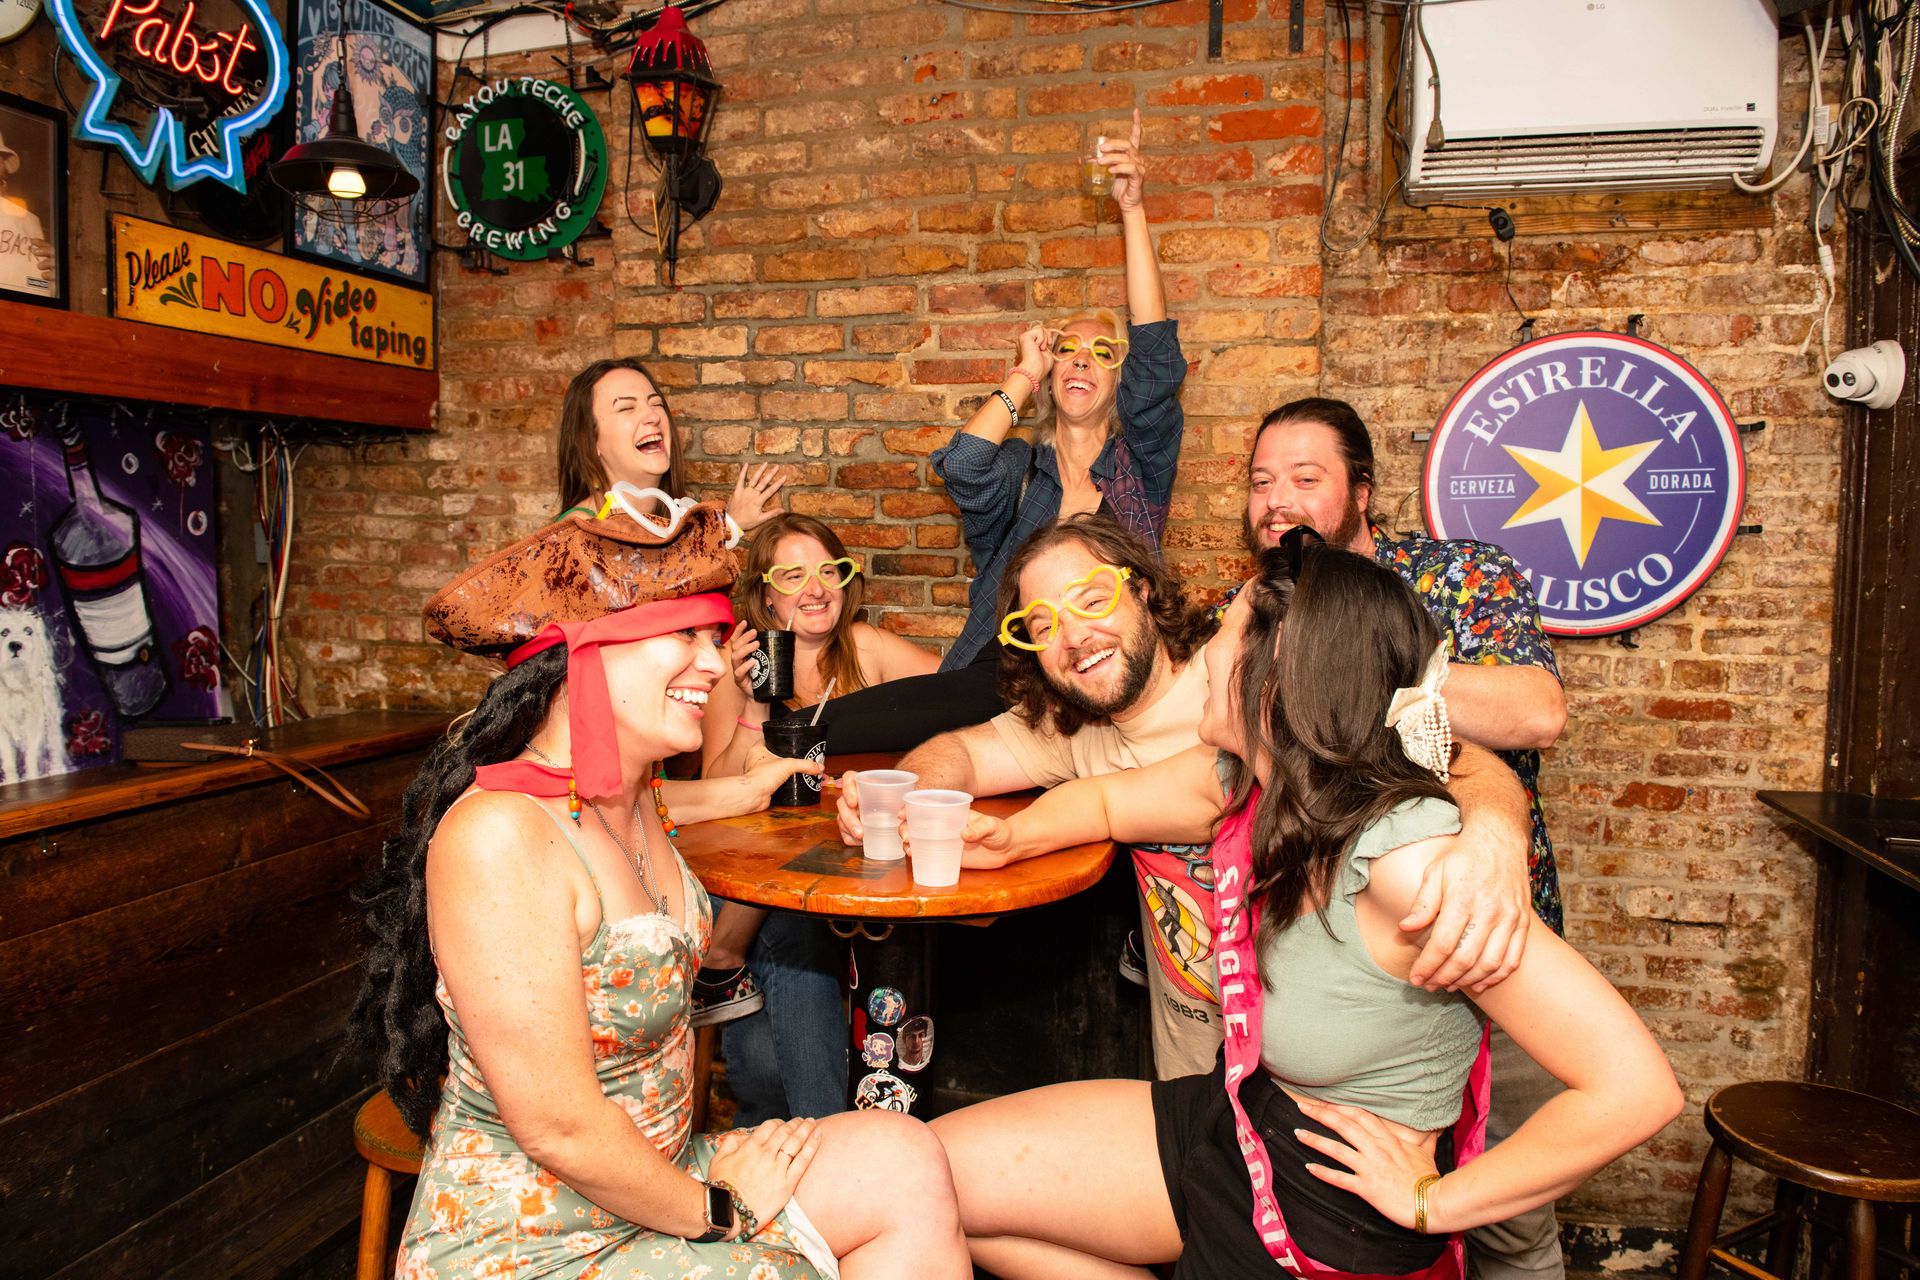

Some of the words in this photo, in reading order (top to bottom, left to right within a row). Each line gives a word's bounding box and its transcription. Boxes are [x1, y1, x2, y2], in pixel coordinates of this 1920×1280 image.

[100, 0, 257, 95] Pabst
[446, 78, 508, 141] BAYOU
[520, 76, 584, 130] TECHE
[484, 123, 513, 153] LA
[502, 160, 525, 192] 31
[457, 202, 572, 250] BREWING
[125, 241, 192, 306] Please
[201, 255, 288, 324] NO
[296, 276, 377, 340] Video
[348, 314, 427, 366] taping
[1000, 392, 1015, 412] BLACK
[1462, 356, 1698, 447] ESTRELLA
[1450, 477, 1516, 496] CERVEZA
[1649, 472, 1713, 490] DORADA
[1512, 553, 1674, 612] LISCO
[1213, 864, 1249, 1038] SINGLE
[1164, 992, 1210, 1025] 1983
